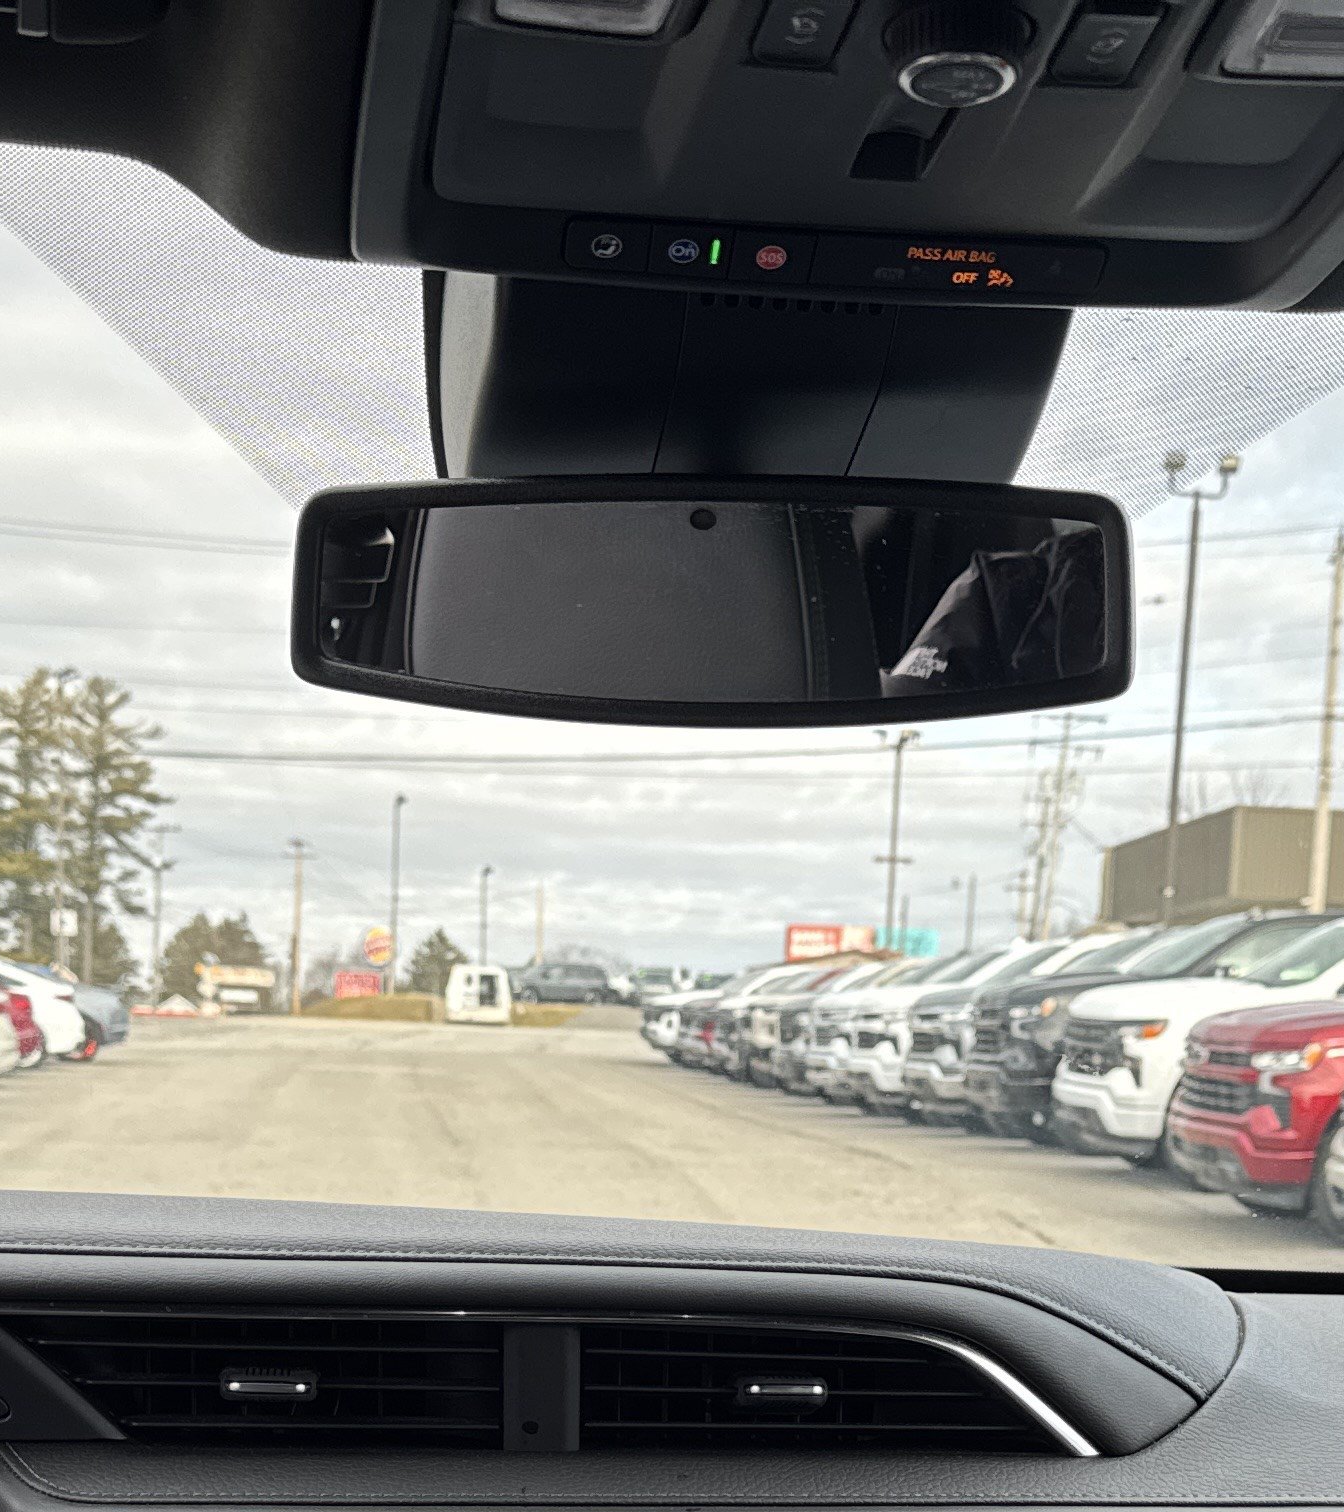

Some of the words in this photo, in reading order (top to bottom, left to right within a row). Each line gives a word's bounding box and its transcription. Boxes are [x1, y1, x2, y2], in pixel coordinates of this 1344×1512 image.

[759, 251, 784, 264] SOS
[906, 246, 942, 261] PASS
[943, 248, 966, 262] AIR
[968, 250, 997, 263] BAG
[951, 271, 979, 284] OFF
